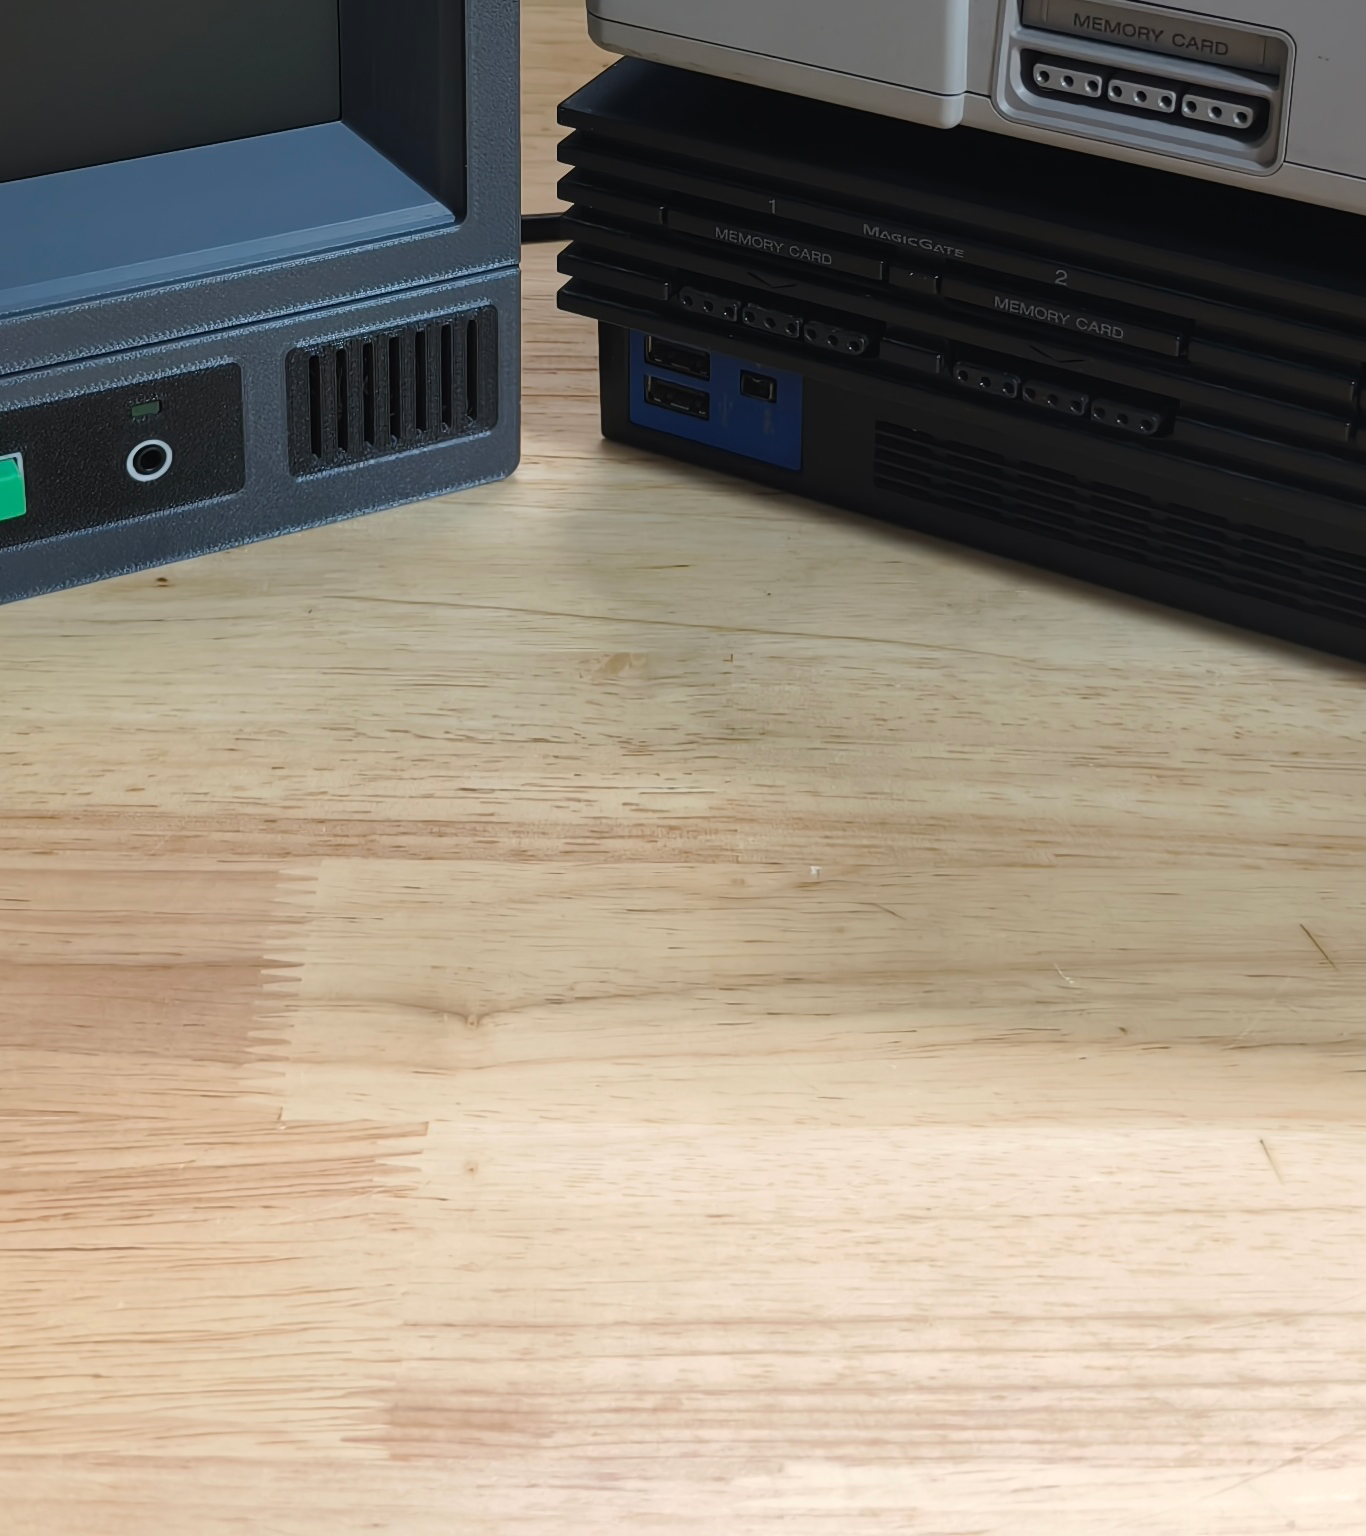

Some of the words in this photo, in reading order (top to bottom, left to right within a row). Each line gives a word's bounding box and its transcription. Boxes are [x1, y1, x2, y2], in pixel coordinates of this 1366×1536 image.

[1073, 13, 1164, 43] MEMORY
[1171, 33, 1229, 56] CARD
[768, 199, 777, 214] 1
[715, 226, 784, 254] MEMORY
[789, 245, 833, 265] CARD
[1054, 269, 1068, 286] 2
[994, 296, 1071, 325] MEMORY
[1076, 317, 1124, 339] CARD
